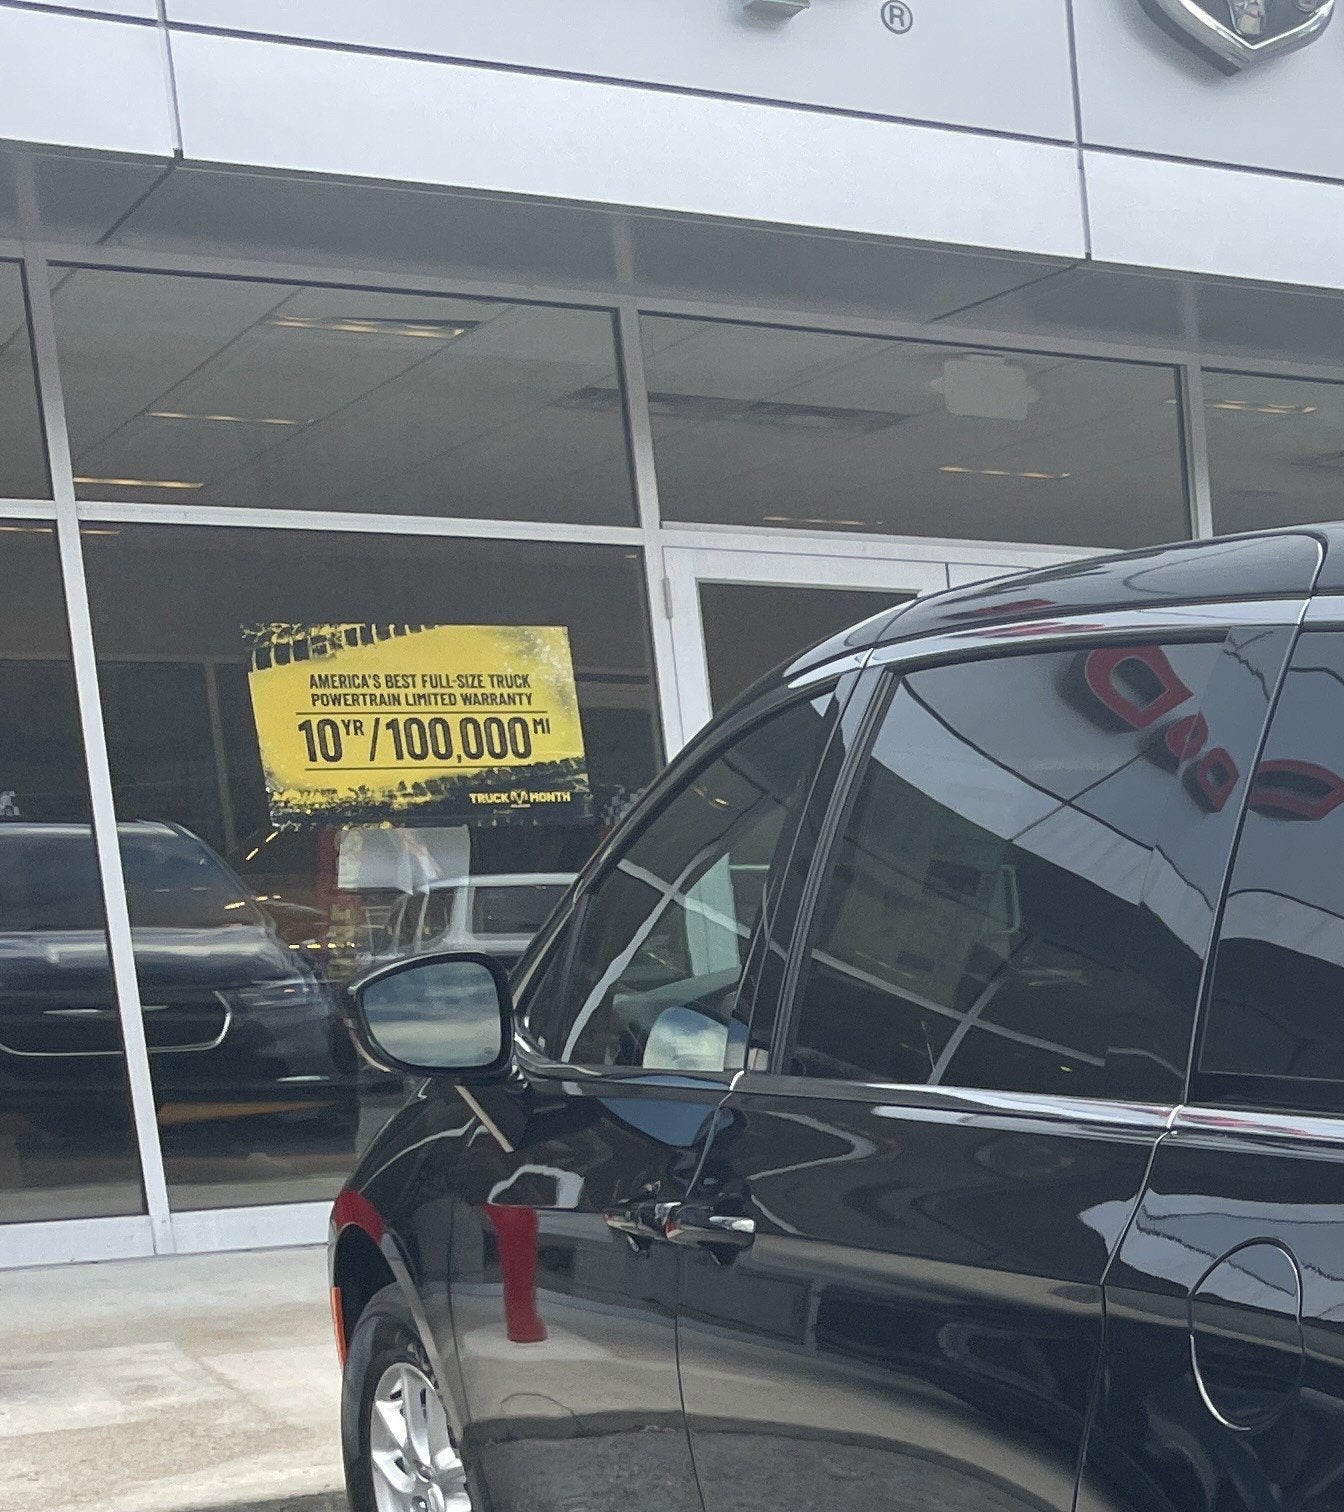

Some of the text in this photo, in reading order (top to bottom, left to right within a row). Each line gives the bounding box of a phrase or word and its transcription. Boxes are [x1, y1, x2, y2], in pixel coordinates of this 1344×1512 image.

[309, 673, 532, 690] AMERICA'S BEST FULL-SIZE TRUCK
[310, 692, 533, 708] POWERTRAIN LIMITED WARRANTY
[469, 791, 571, 804] TRUCK MONTH
